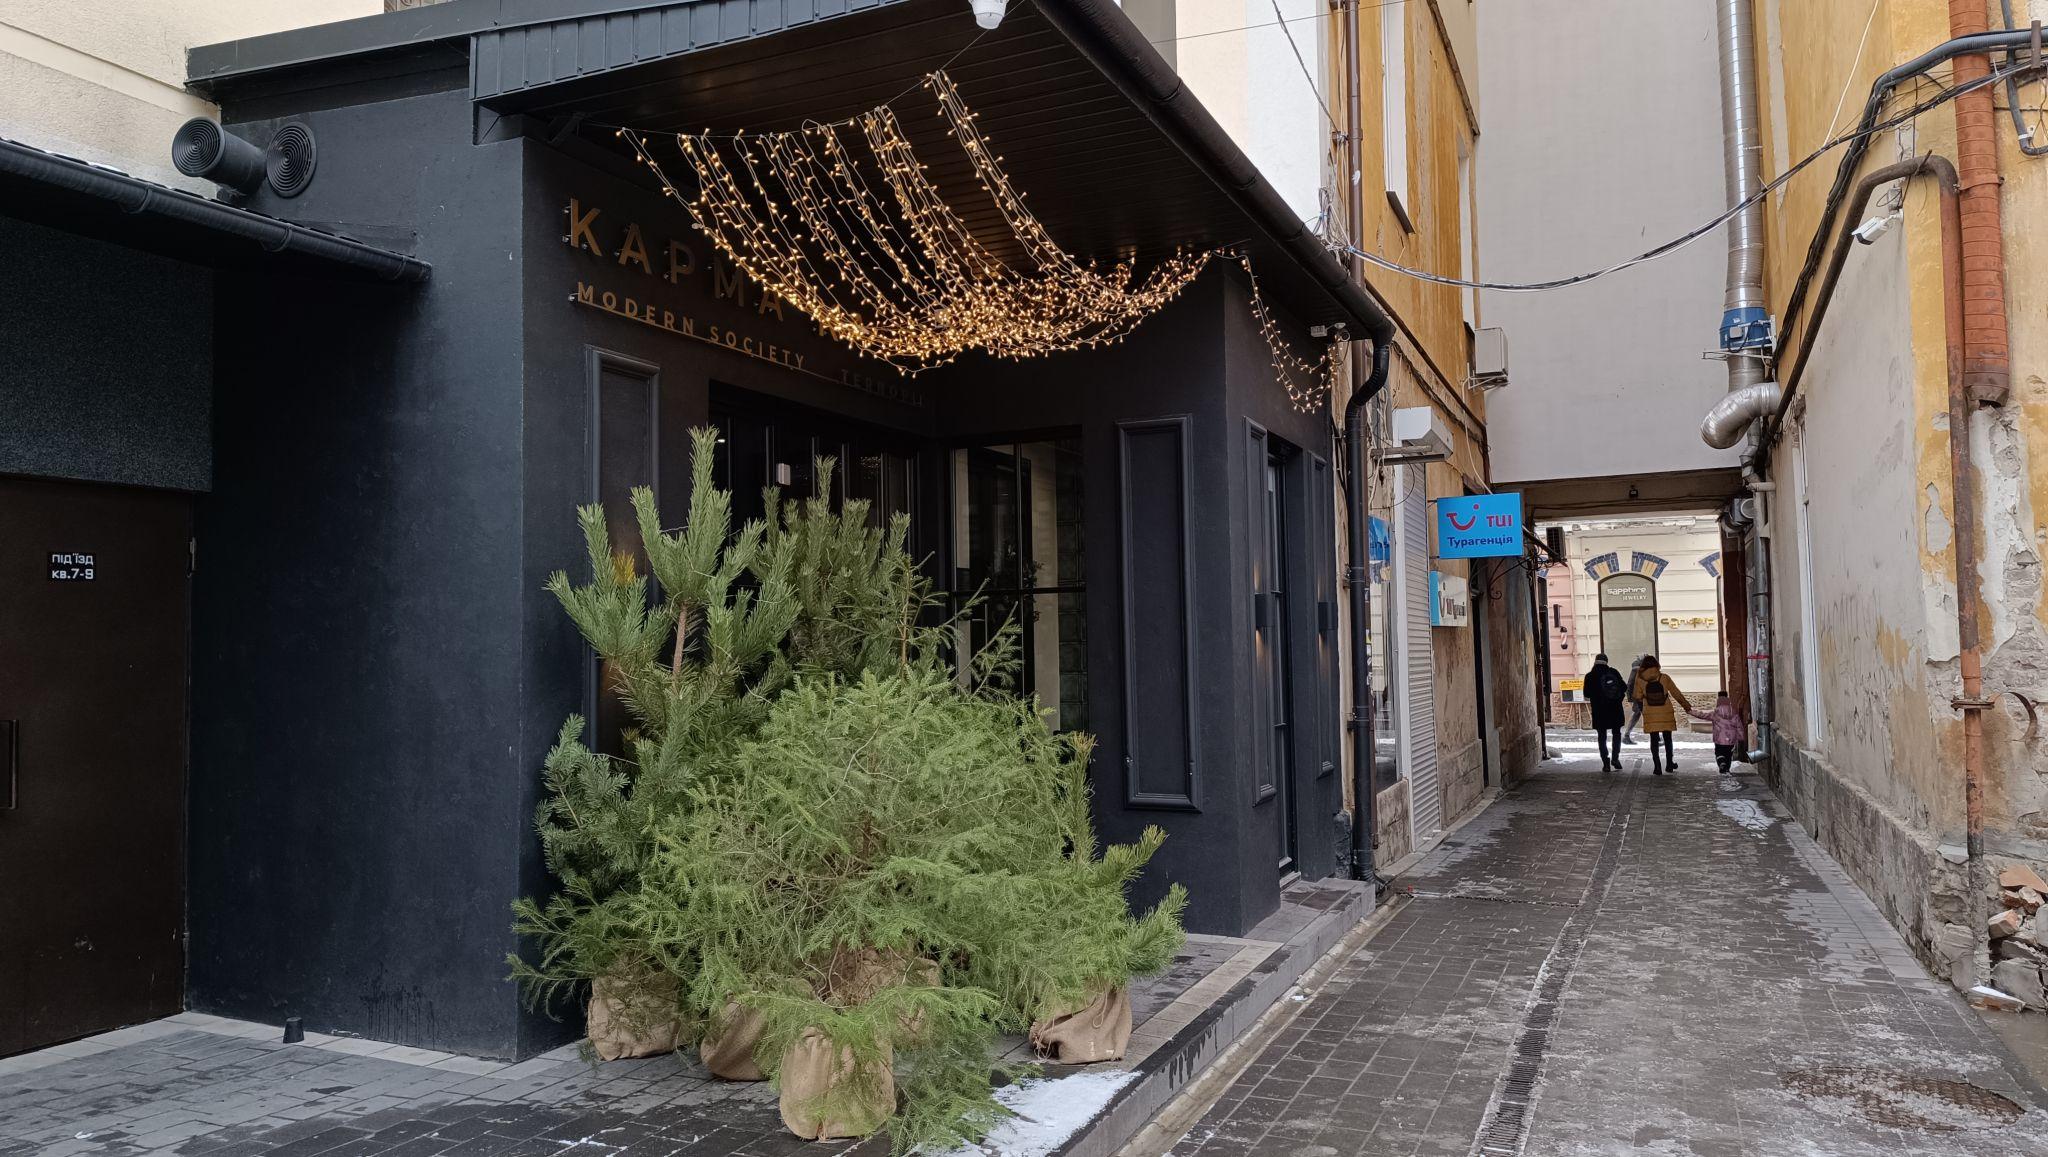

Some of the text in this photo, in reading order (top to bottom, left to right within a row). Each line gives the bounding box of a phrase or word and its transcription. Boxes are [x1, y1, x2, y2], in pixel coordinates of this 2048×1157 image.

[577, 281, 695, 335] MODERN
[710, 325, 805, 370] SOCIETY
[1486, 514, 1512, 527] TUI
[1447, 535, 1513, 548] Турагенція
